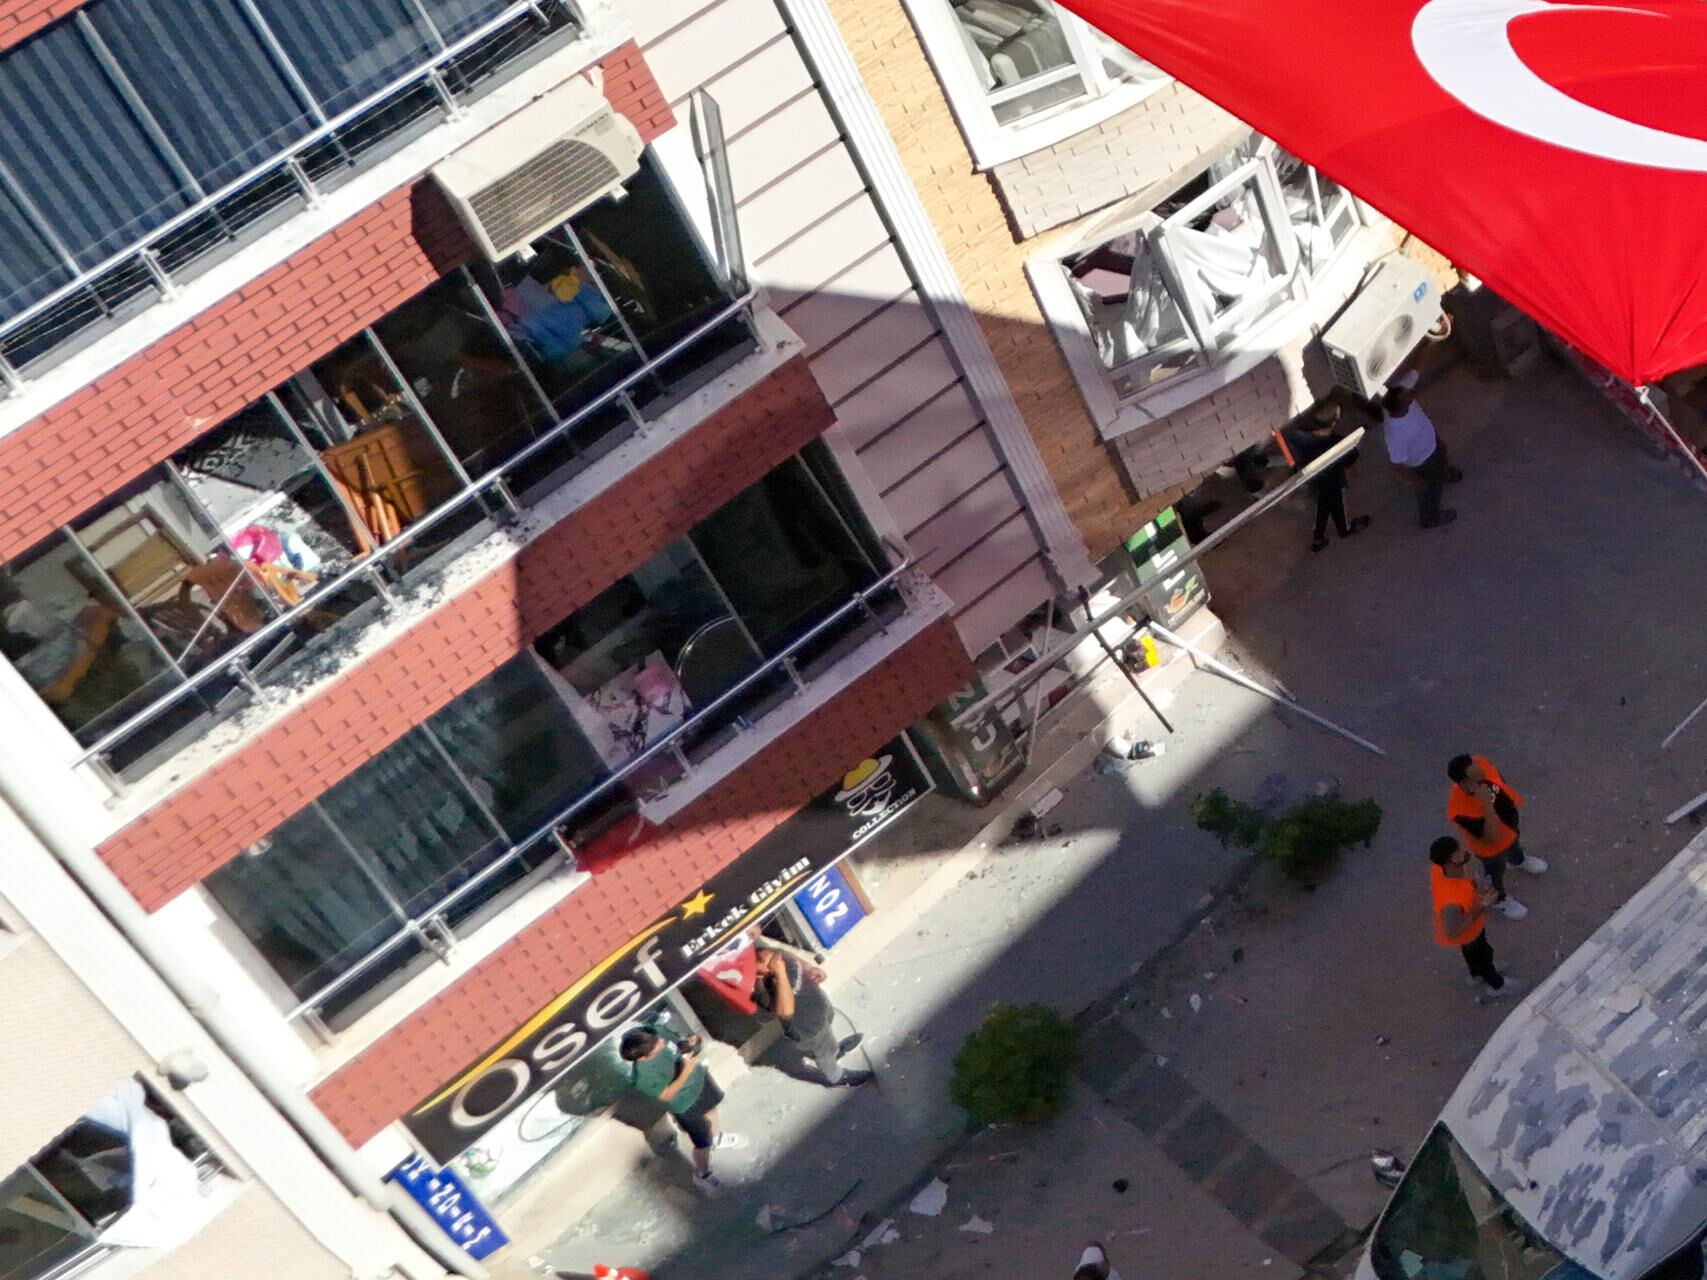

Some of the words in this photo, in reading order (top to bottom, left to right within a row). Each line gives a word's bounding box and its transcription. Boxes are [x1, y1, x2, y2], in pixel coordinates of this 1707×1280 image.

[852, 788, 916, 840] COLLECTION
[449, 934, 667, 1128] Osef
[681, 905, 749, 959] Erkek
[749, 856, 811, 906] Giyim
